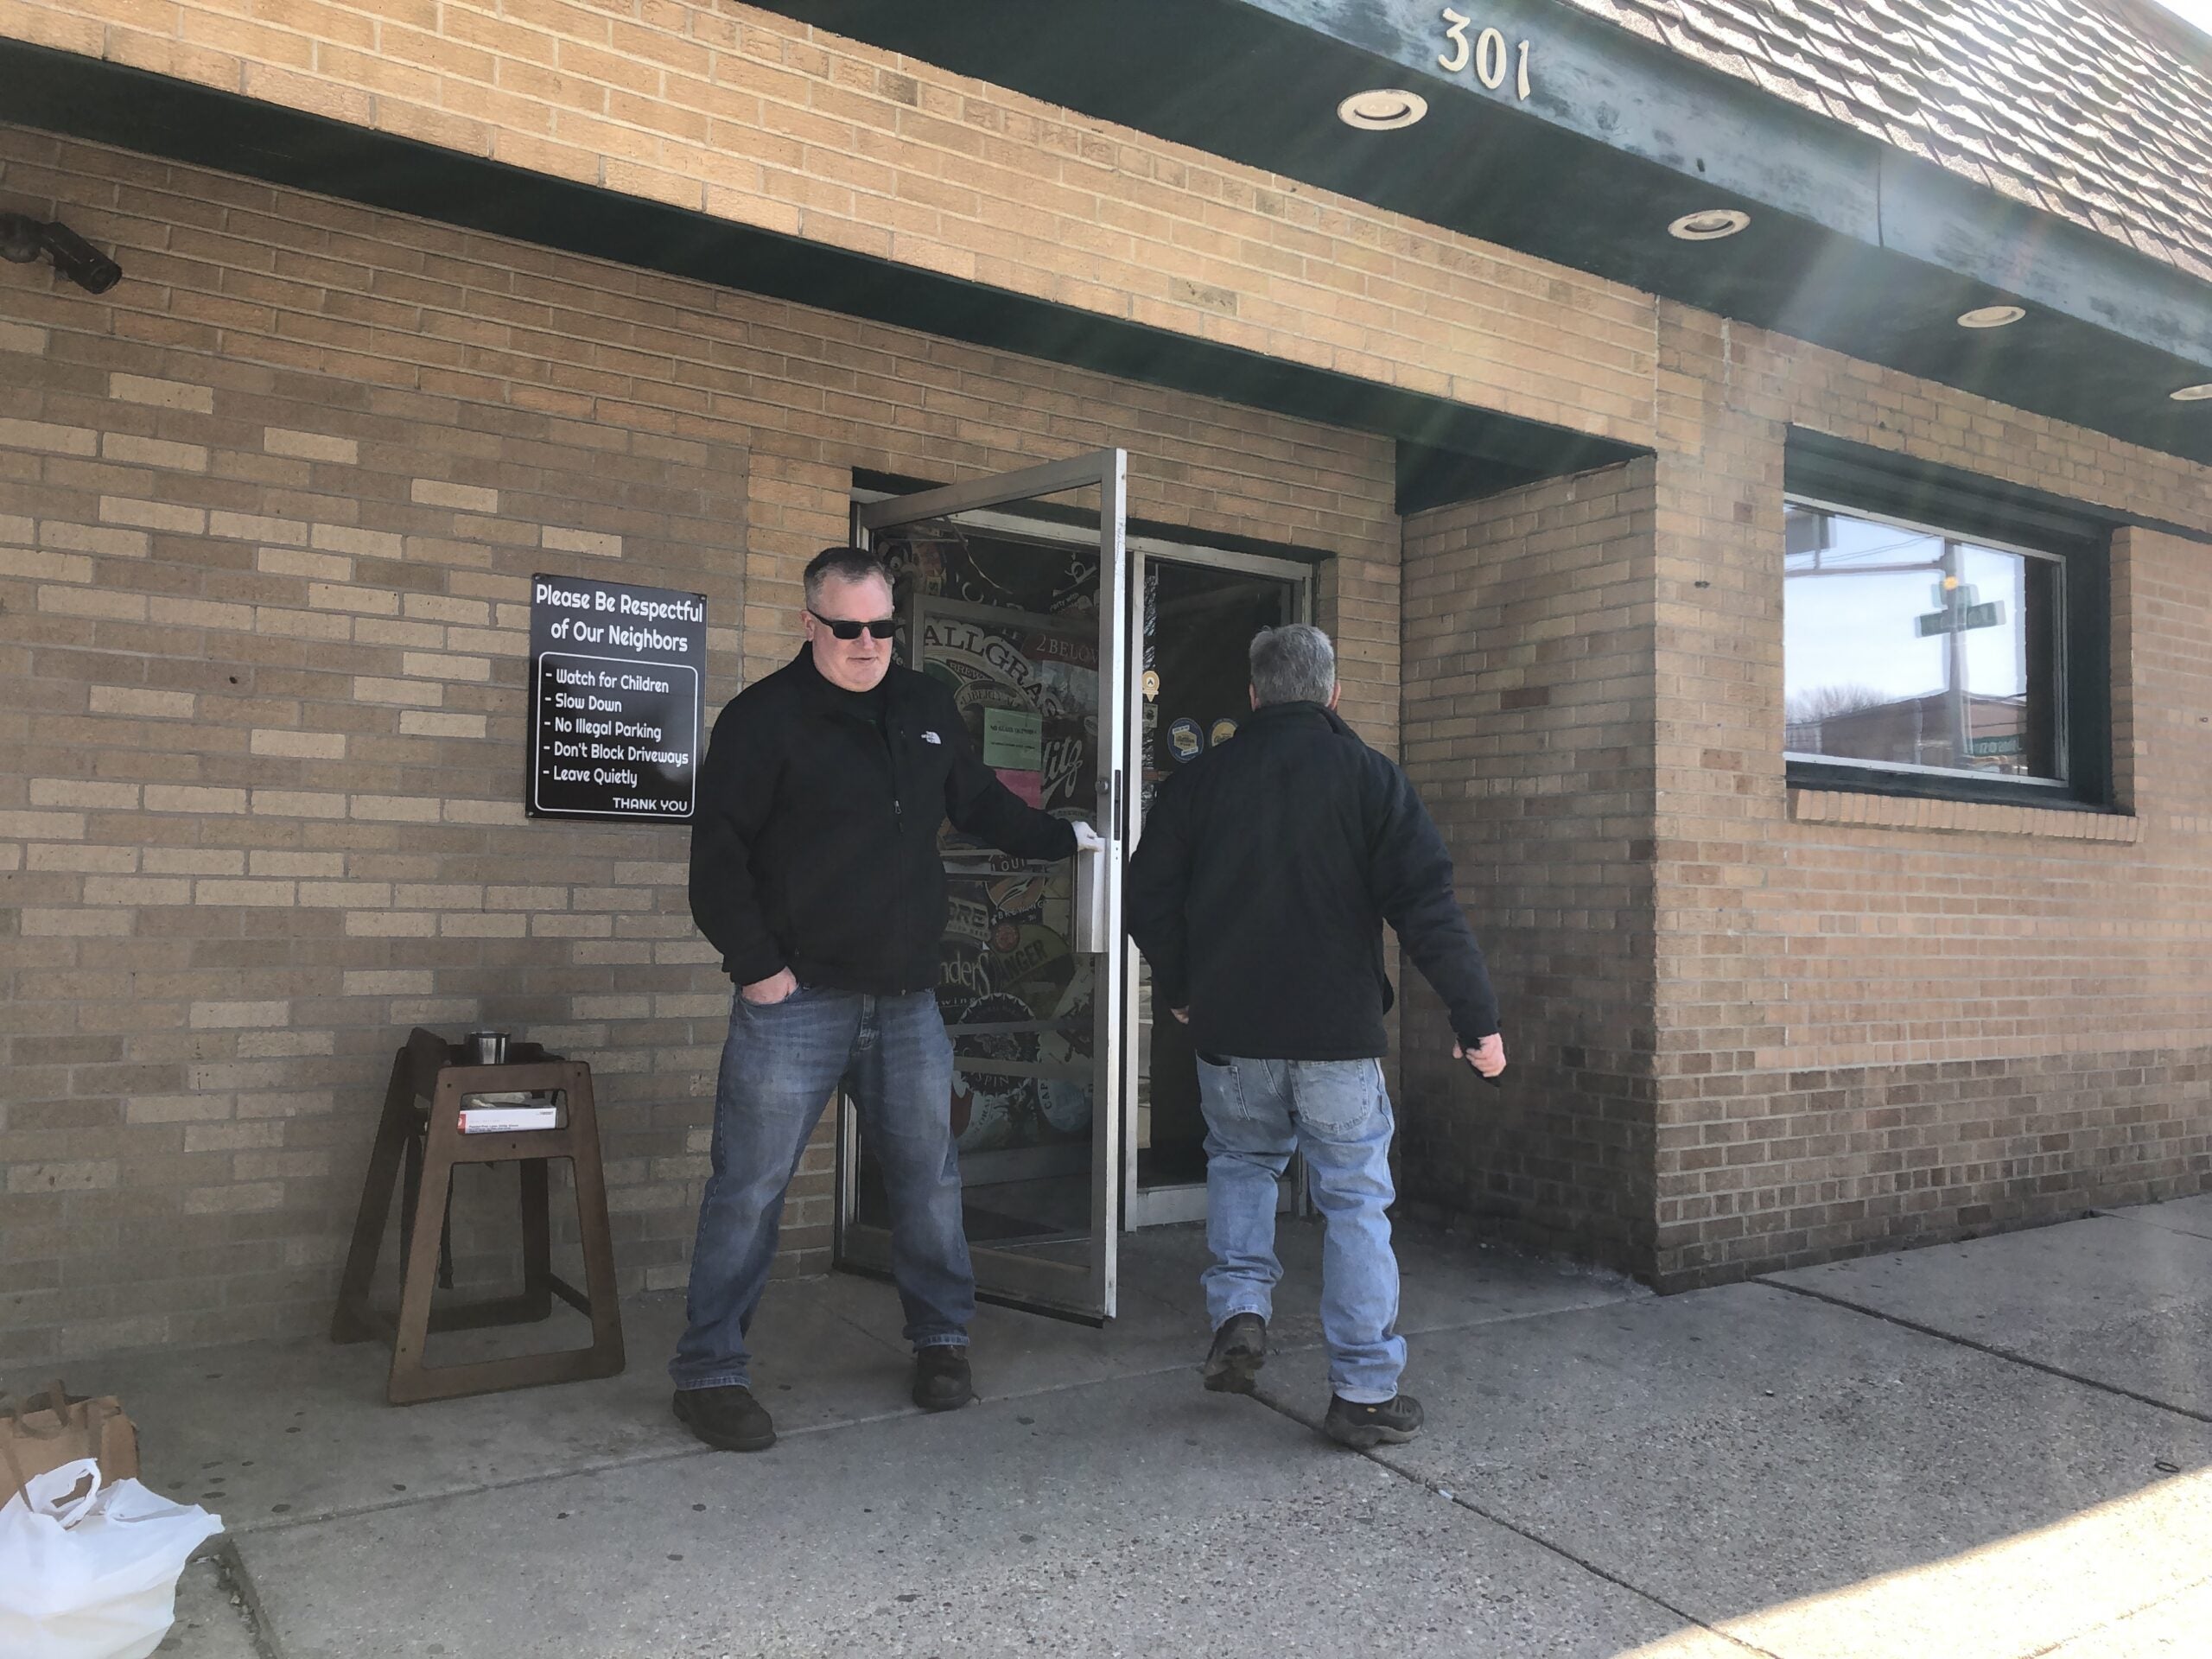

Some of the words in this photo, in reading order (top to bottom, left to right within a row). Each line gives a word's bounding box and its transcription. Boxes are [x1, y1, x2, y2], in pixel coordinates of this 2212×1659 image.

[1438, 7, 1531, 101] 301
[537, 584, 589, 608] Please
[595, 591, 615, 612] Be
[620, 594, 702, 622] Respectful
[551, 619, 569, 639] of
[574, 622, 604, 643] Our
[609, 626, 688, 652] Neighbors
[1036, 633, 1047, 652] 2
[556, 669, 595, 686] Watch
[600, 671, 617, 688] for
[620, 675, 669, 693] Children
[556, 693, 584, 709] Slow
[589, 696, 622, 712] Down
[555, 717, 572, 733] No
[576, 719, 612, 738] Illegal
[615, 721, 661, 741] Parking
[555, 741, 588, 758] Don't
[591, 744, 624, 760] Block
[629, 747, 689, 767] Driveways
[553, 766, 590, 783] Leave
[594, 768, 637, 788] Quietly
[613, 798, 657, 810] THANK
[660, 799, 687, 811] YOU
